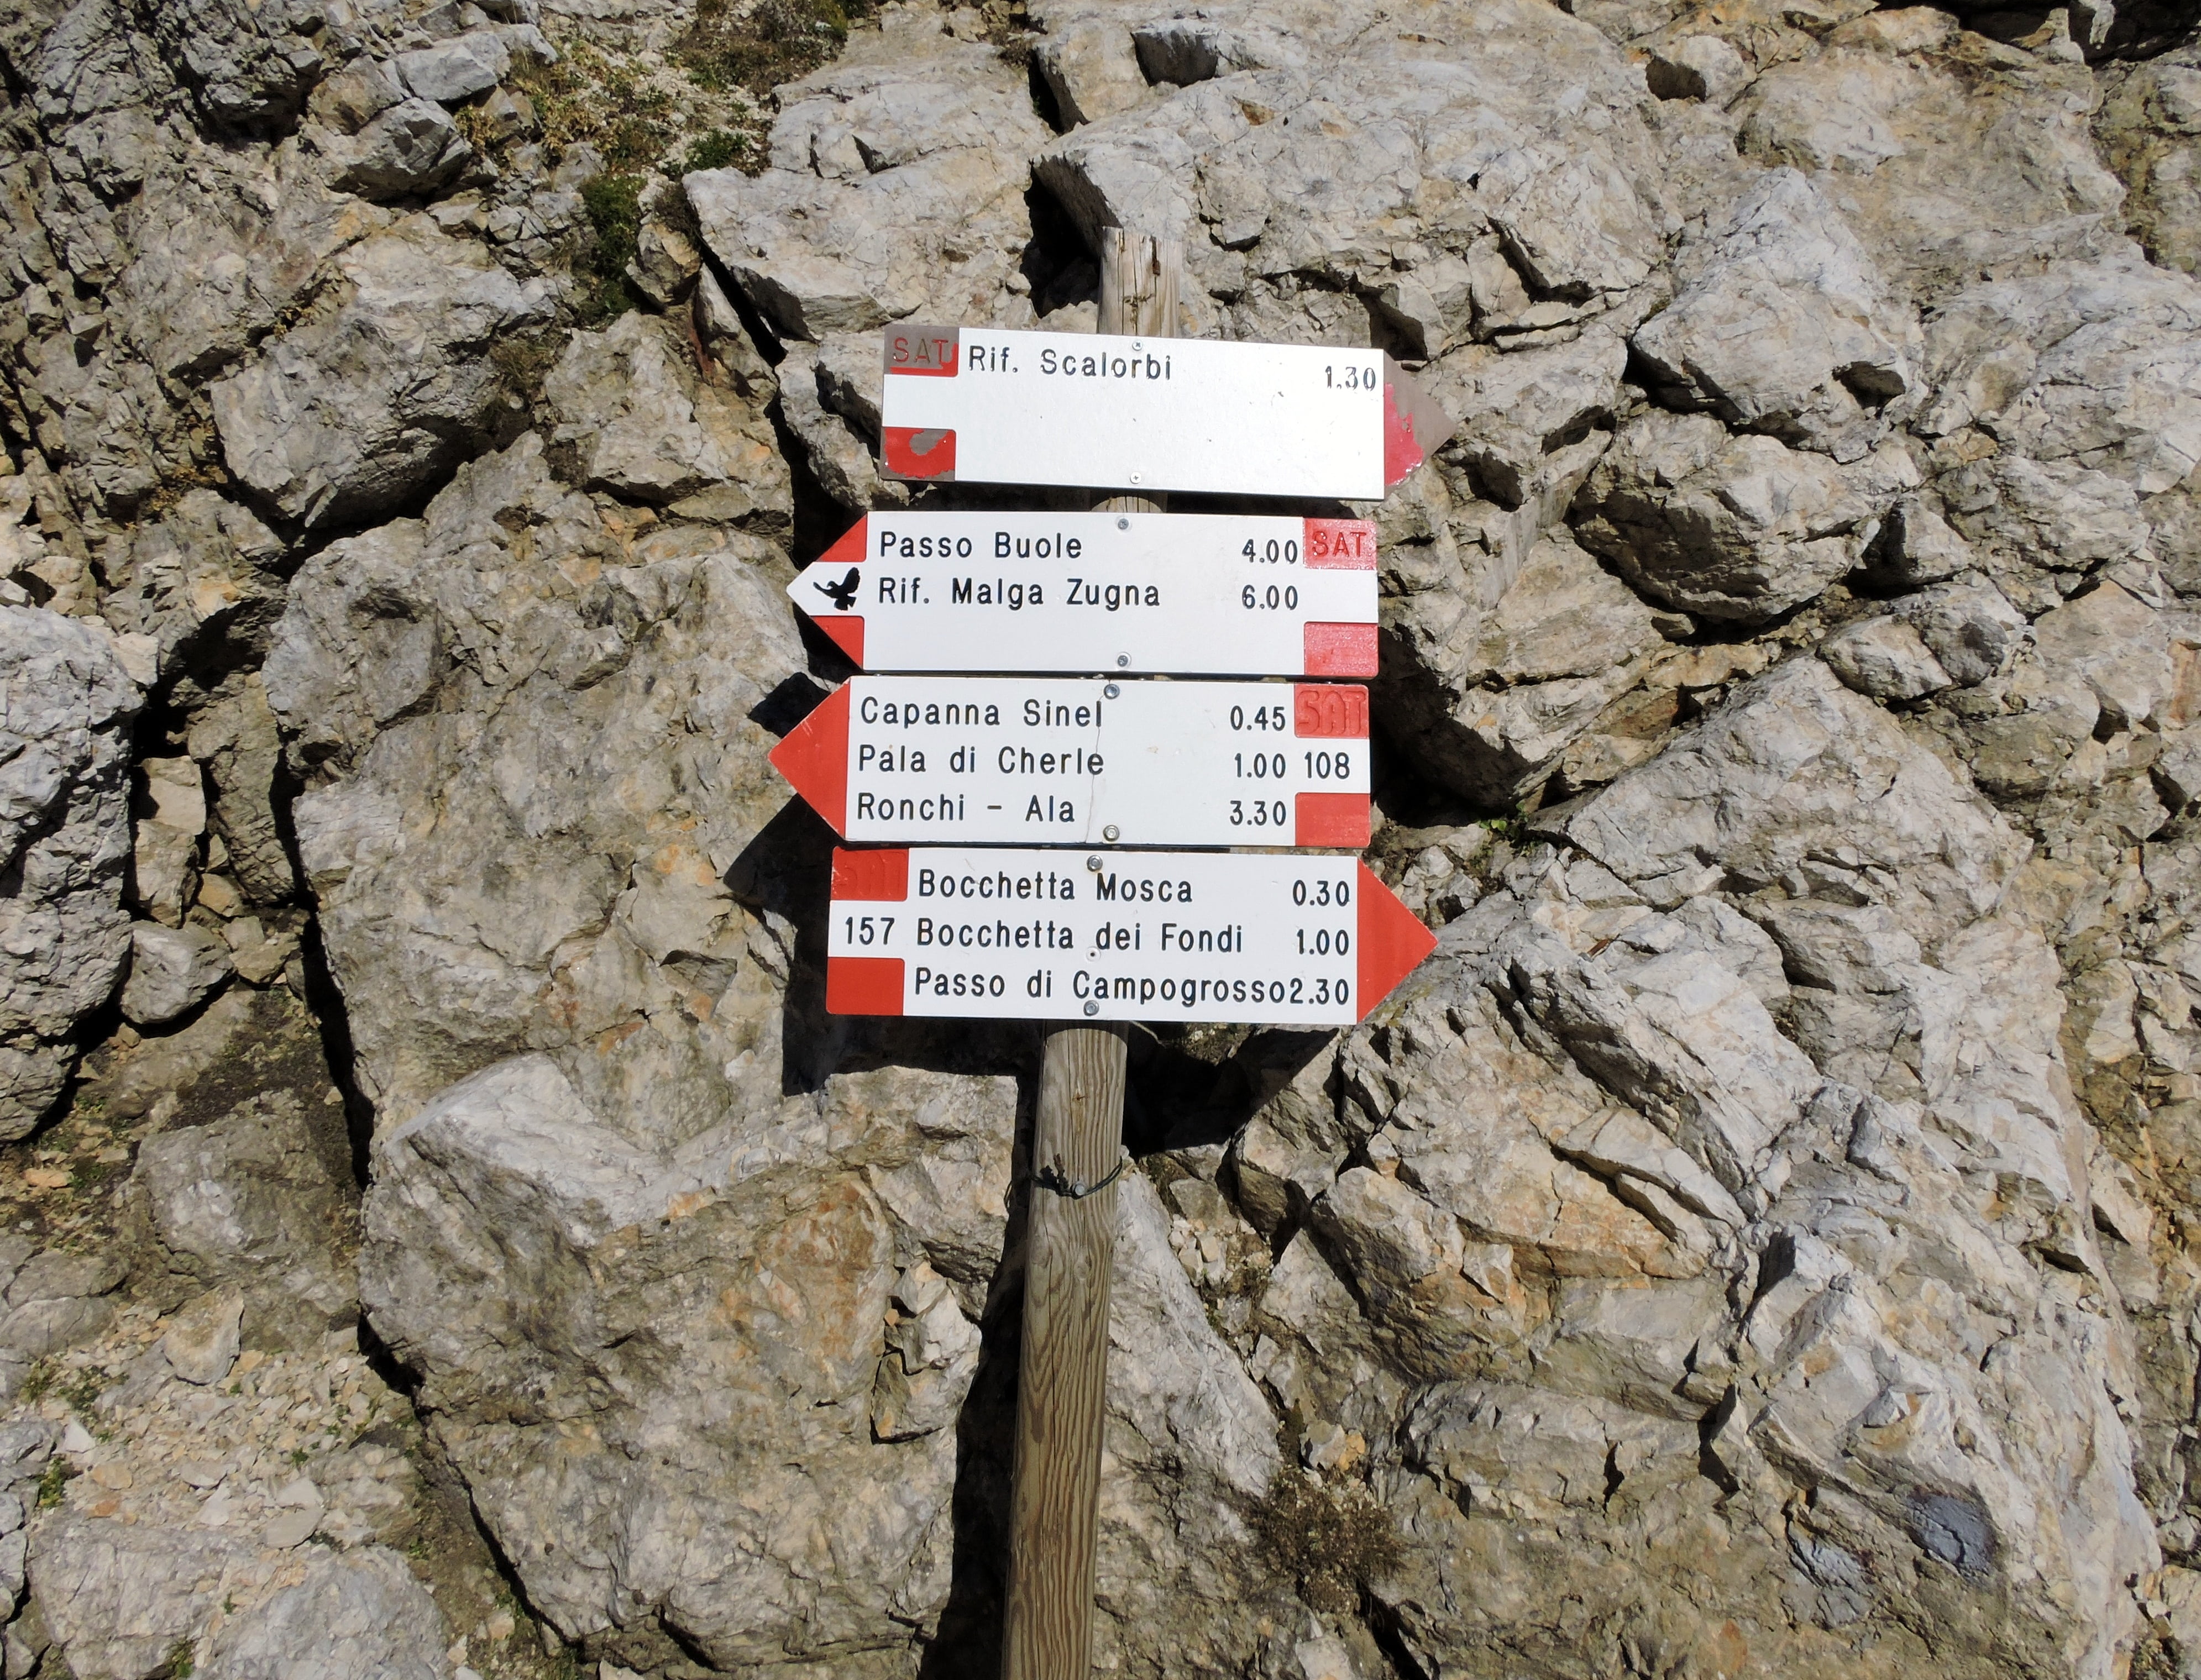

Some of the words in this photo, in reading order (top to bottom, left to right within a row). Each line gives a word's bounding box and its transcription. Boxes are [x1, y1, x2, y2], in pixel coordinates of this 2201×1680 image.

[893, 338, 949, 364] SAT
[969, 345, 1018, 372] Rif.
[1040, 349, 1170, 380] Scalorbi
[1325, 366, 1376, 389] 1.30
[881, 531, 972, 558] Passo
[995, 532, 1082, 559] Buole
[1242, 539, 1298, 564] 4.00
[1312, 531, 1367, 558] SAT
[879, 577, 929, 604] Rif.
[952, 578, 1044, 609] Malga
[1066, 578, 1160, 610] Zugna
[1242, 585, 1298, 610] 6.00
[861, 696, 1000, 729] Capanna
[1024, 699, 1102, 727] Sinel
[1230, 705, 1286, 731] 0.45
[1296, 690, 1366, 734] SAT
[859, 744, 926, 773] Pala
[950, 746, 975, 773] di
[998, 746, 1104, 775] Cherle
[1234, 753, 1286, 779] 1.00
[1304, 752, 1350, 779] 108
[858, 792, 964, 821] Ronchi
[1025, 795, 1075, 822] Ala
[1230, 800, 1286, 826] 3.30
[919, 869, 1075, 900] Bocchetta
[1097, 873, 1192, 902] Mosca
[1292, 880, 1349, 907] 0.30
[846, 916, 895, 946] 157
[917, 917, 1073, 949] Bocchetta
[1096, 921, 1140, 951] dei
[1161, 923, 1241, 953] Fondi
[1297, 929, 1349, 956] 1.00
[915, 967, 1005, 997] Passo
[1027, 969, 1051, 998] di
